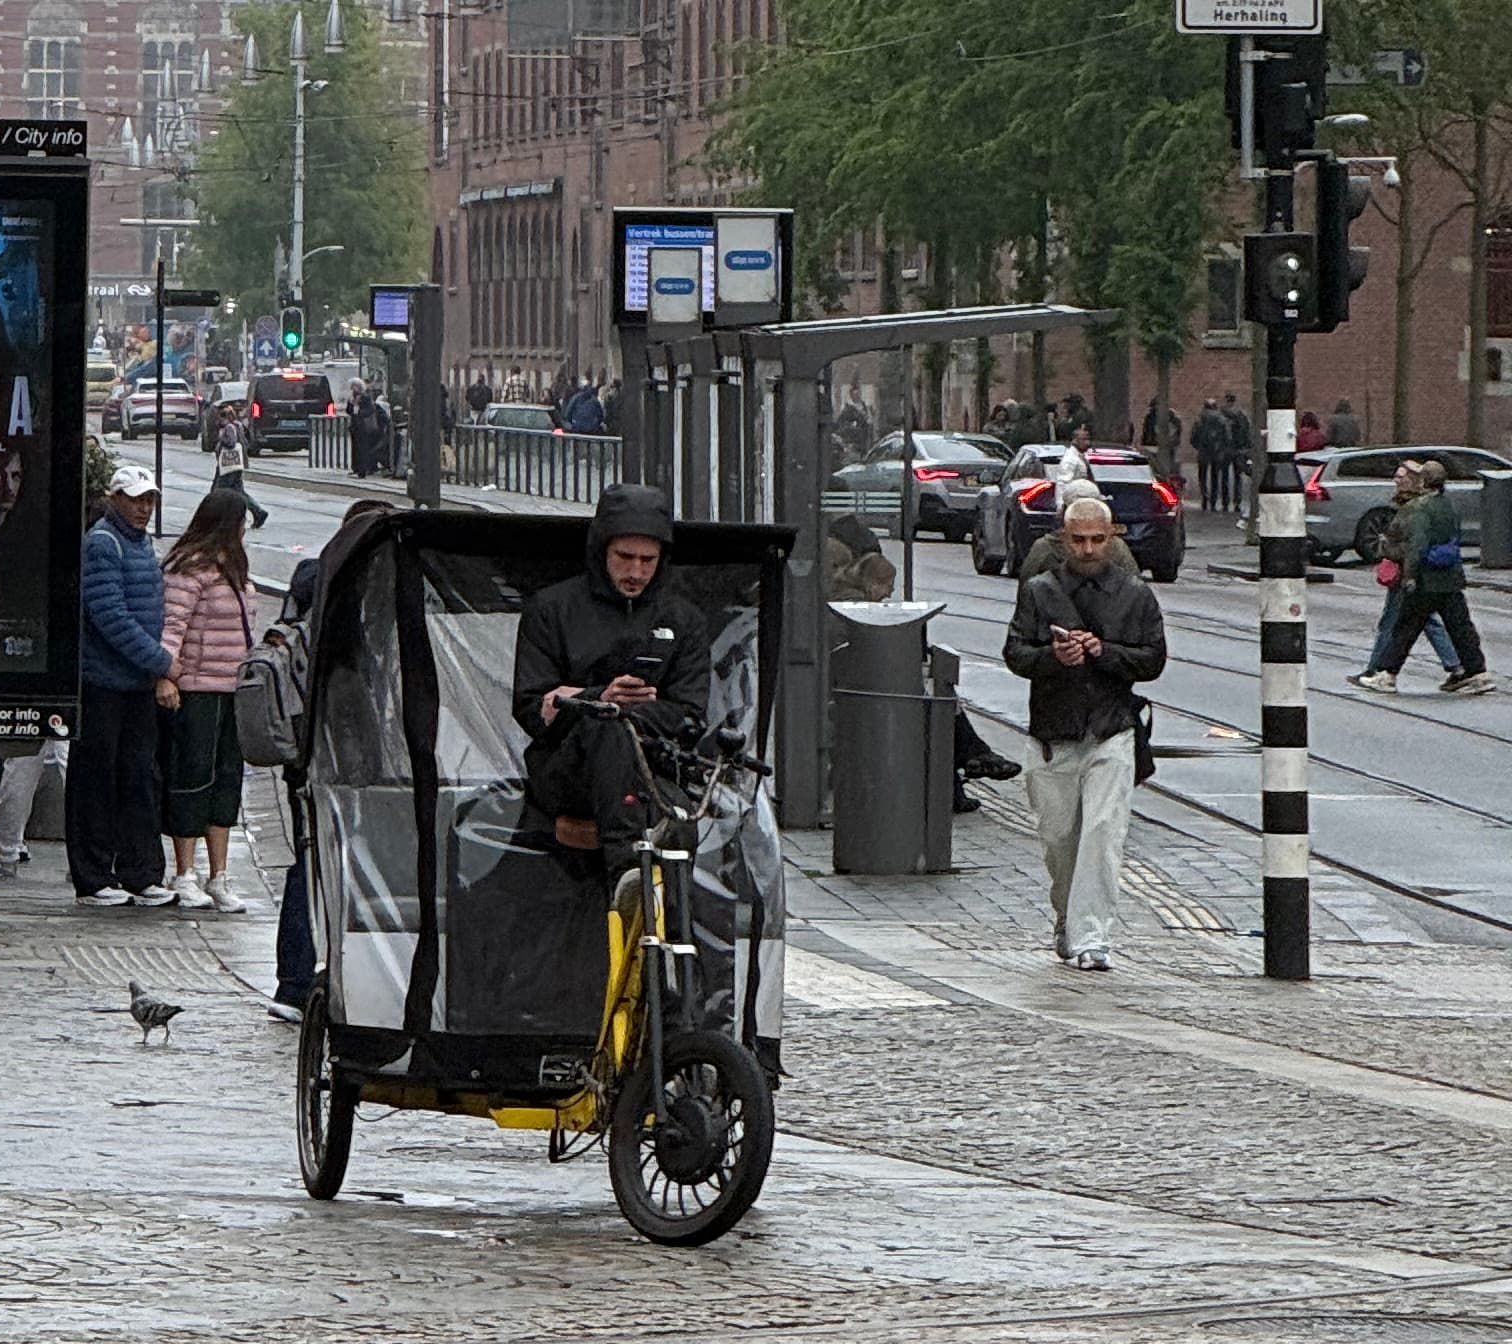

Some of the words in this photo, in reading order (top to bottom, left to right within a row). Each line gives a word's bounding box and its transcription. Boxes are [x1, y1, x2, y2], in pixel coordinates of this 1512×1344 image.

[1213, 9, 1288, 24] Herhaling
[14, 127, 48, 148] City
[51, 128, 83, 145] info
[88, 284, 119, 296] traal
[15, 707, 41, 720] info
[14, 723, 40, 736] info
